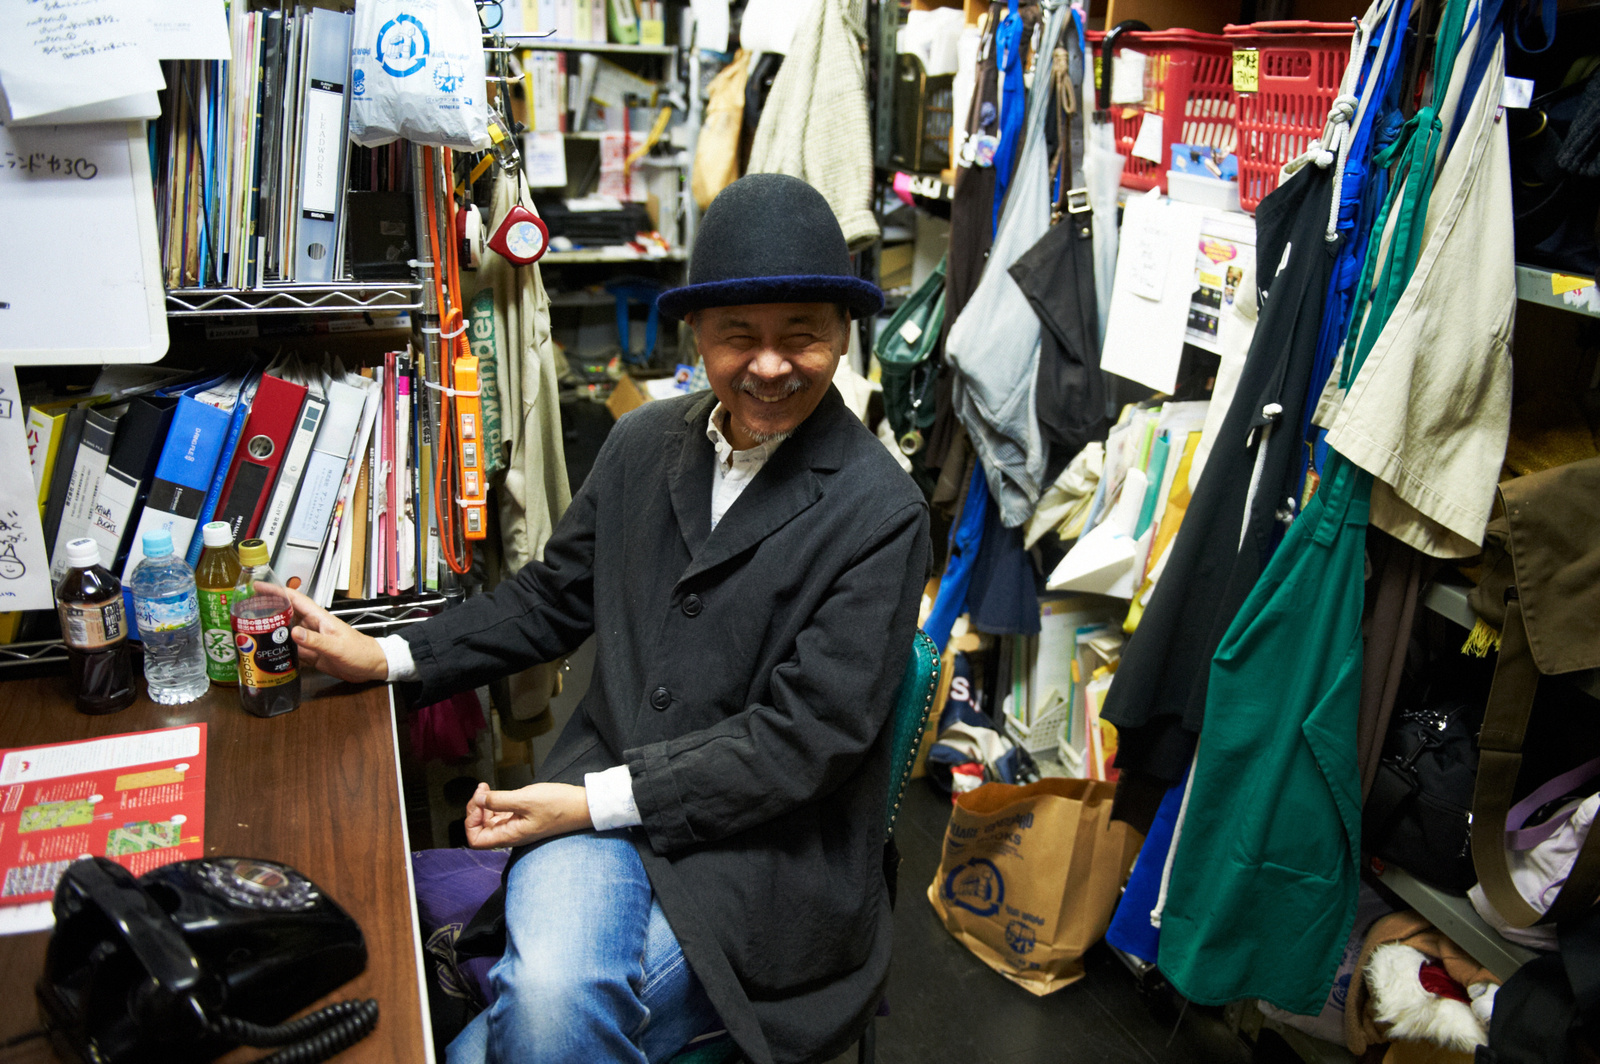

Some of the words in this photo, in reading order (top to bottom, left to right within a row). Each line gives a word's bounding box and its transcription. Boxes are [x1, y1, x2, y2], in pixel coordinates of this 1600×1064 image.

[316, 113, 326, 188] LEADWORKS
[471, 305, 499, 426] wander
[269, 516, 280, 536] 株式会社
[208, 632, 235, 659] 茶
[256, 645, 290, 659] SPECIAL
[242, 654, 257, 687] pepsi
